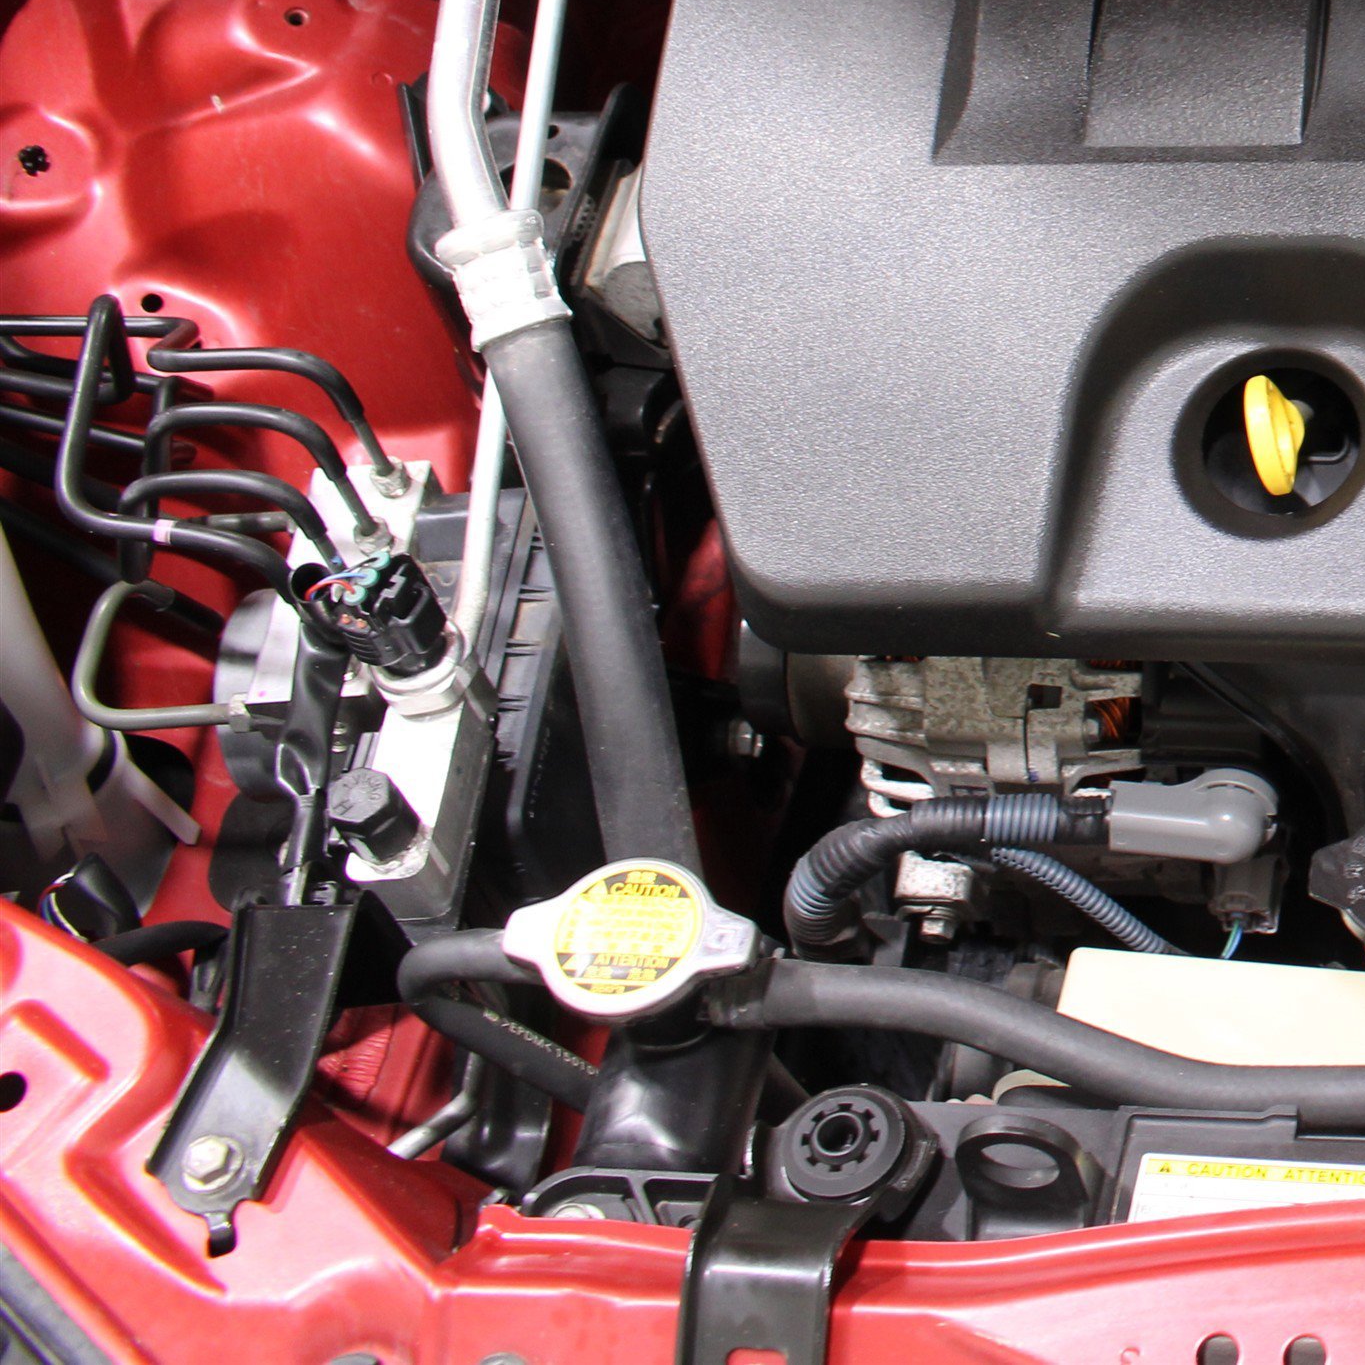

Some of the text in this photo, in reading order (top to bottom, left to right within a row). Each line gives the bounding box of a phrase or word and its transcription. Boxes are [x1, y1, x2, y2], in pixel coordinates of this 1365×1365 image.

[611, 882, 682, 898] CAUTION
[594, 953, 671, 969] ATTENTION
[1186, 1162, 1267, 1180] CAUTION
